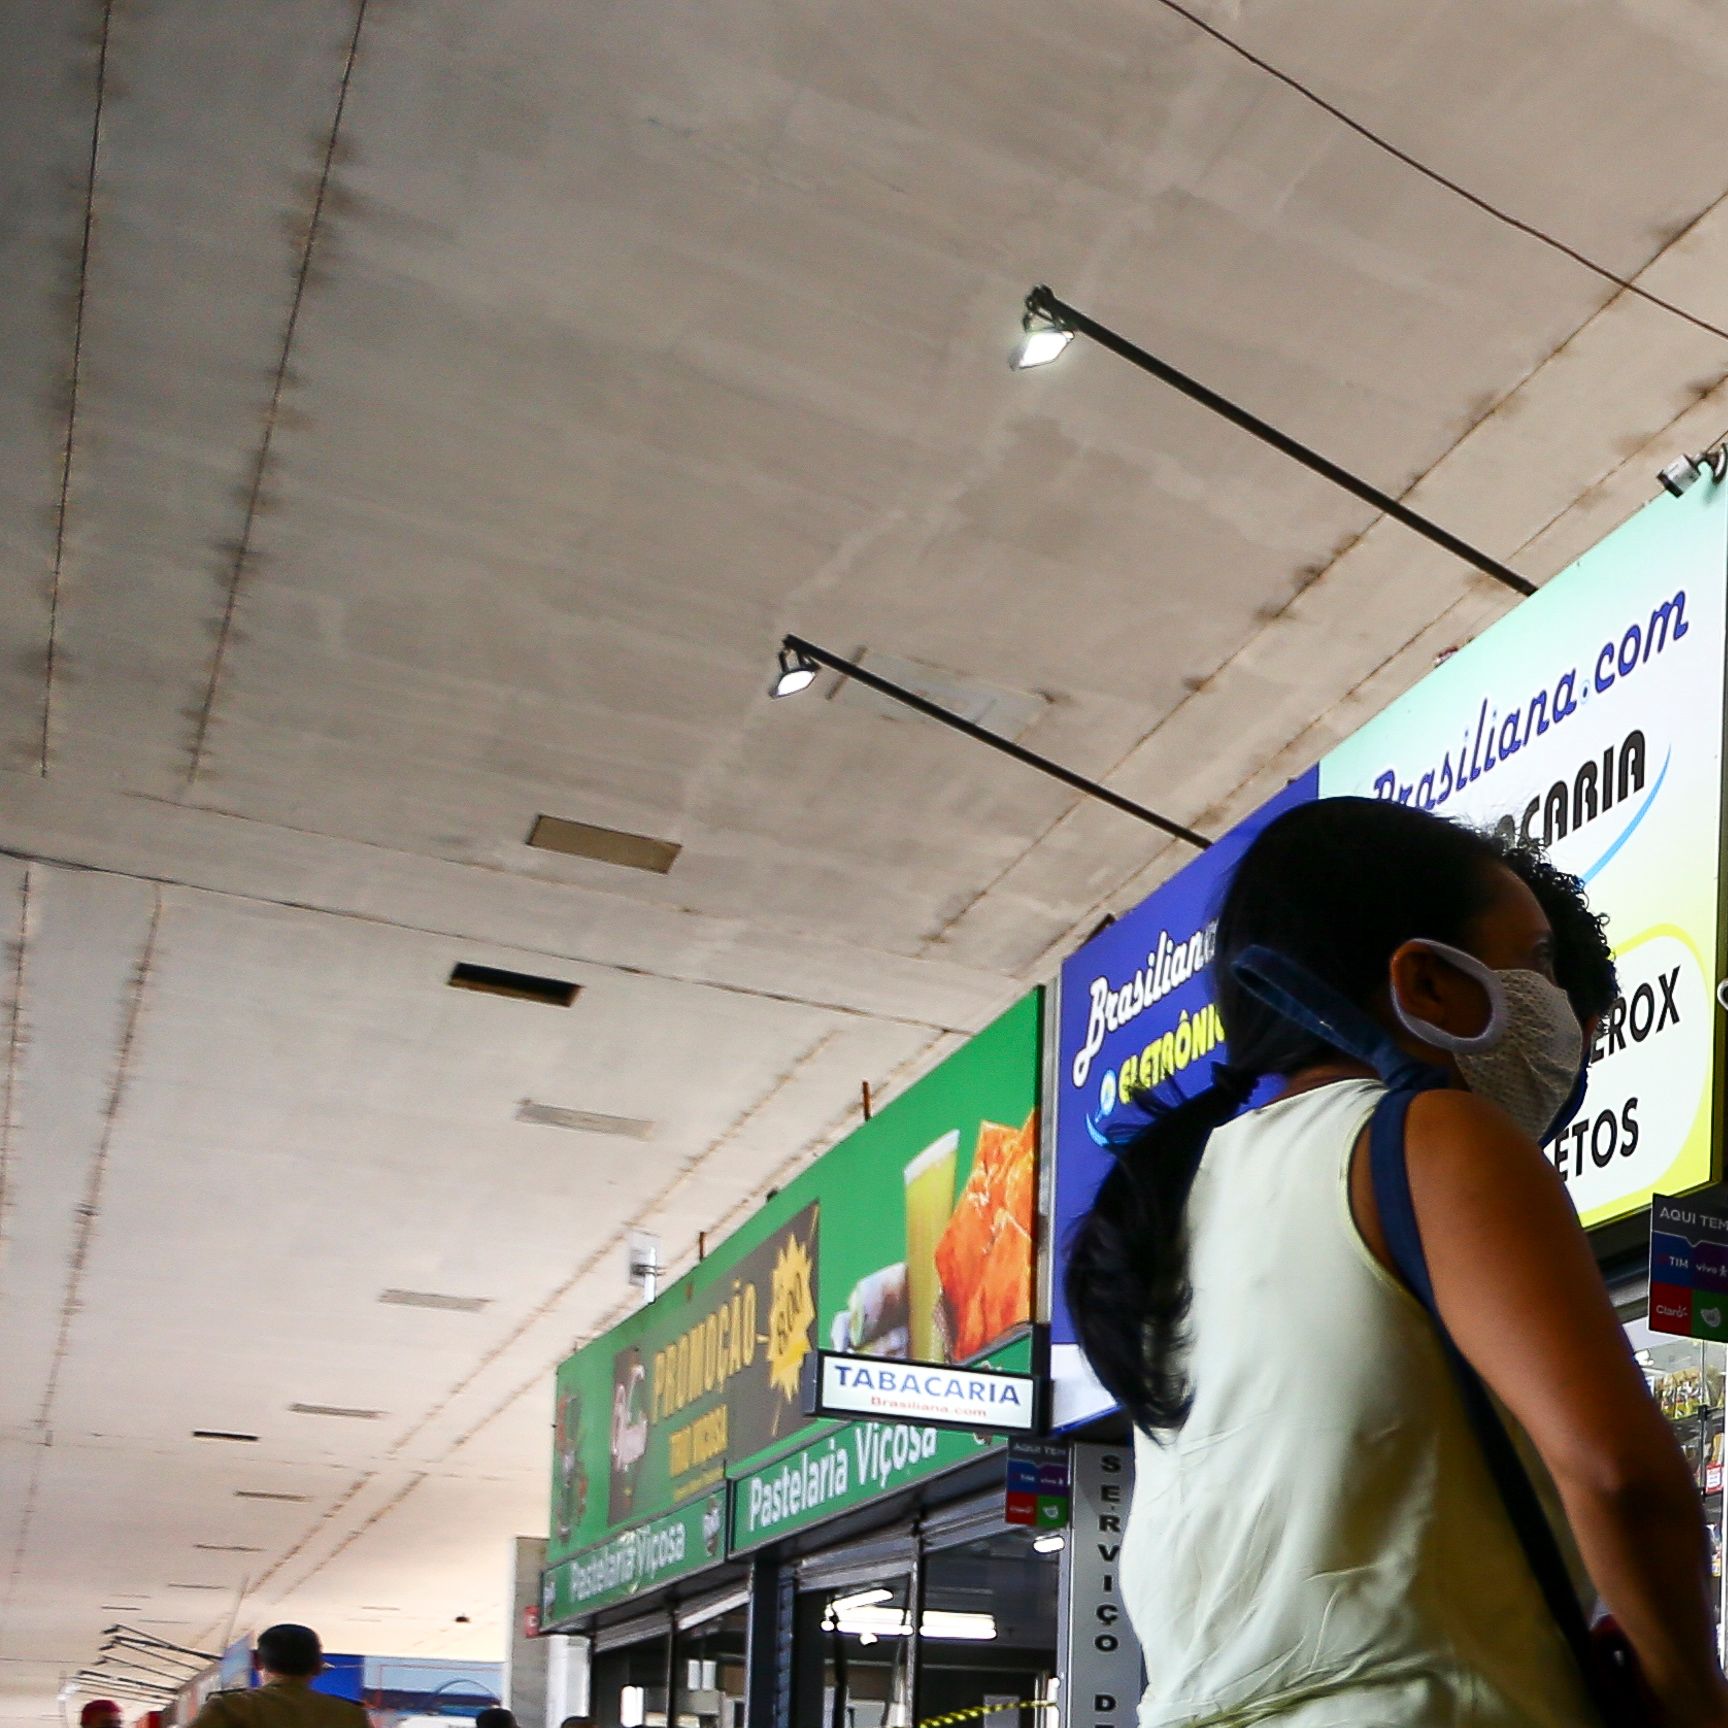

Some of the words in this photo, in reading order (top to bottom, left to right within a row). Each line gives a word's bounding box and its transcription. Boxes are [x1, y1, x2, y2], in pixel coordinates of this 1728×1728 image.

[1591, 965, 1681, 1064] EROX
[1659, 1207, 1696, 1225] AQUI
[1702, 1214, 1728, 1232] TEM
[1669, 1256, 1688, 1269] TIM
[1656, 1305, 1685, 1318] Claro
[835, 1365, 1020, 1406] TABACARIA
[871, 1396, 986, 1417] Brasiliana.com
[750, 1438, 848, 1531] Pastelaria
[855, 1422, 937, 1489] Viçosa
[1096, 1454, 1121, 1652] SERVIÇO
